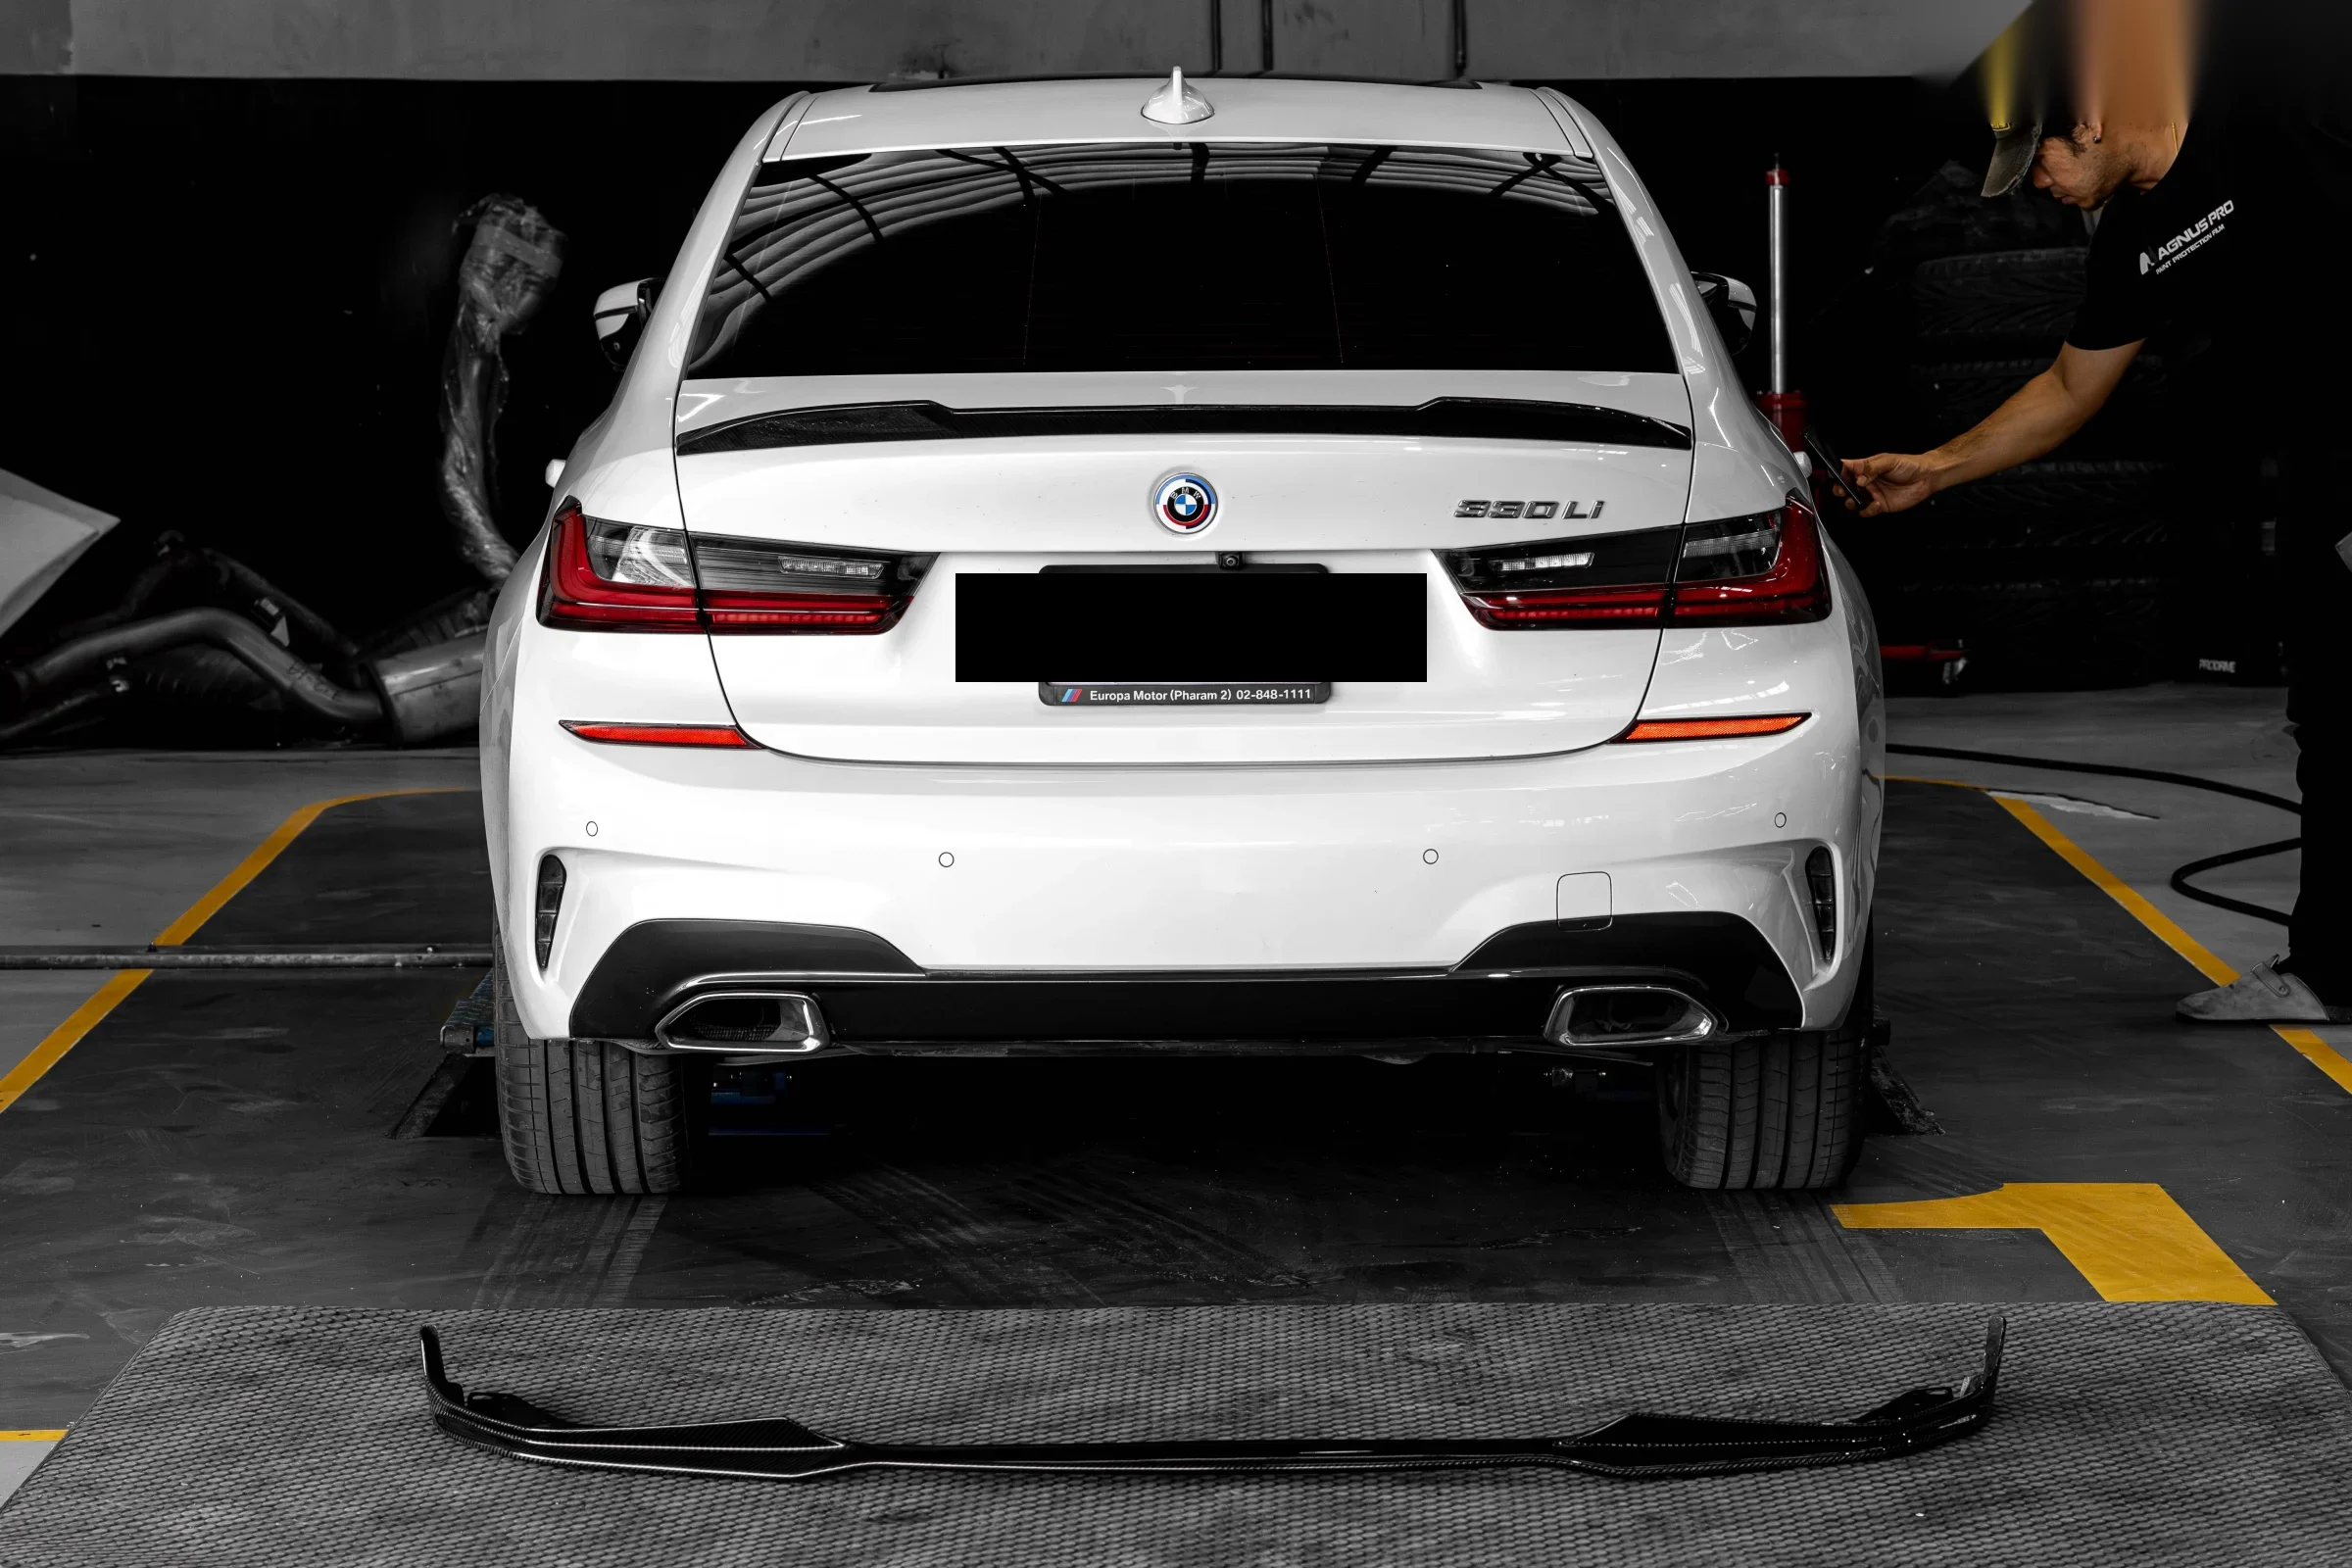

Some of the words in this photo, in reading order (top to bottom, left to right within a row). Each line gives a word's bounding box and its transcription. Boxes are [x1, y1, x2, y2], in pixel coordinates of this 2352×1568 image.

[2207, 199, 2234, 225] PRO
[2155, 260, 2173, 275] PAINT
[2172, 232, 2213, 264] PROTECTION
[2211, 223, 2226, 236] FILM
[1169, 487, 1201, 500] BMW
[1090, 690, 1131, 703] Europa
[1133, 690, 1168, 701] Motor
[1169, 689, 1218, 702] (Pharam
[1220, 688, 1232, 701] 2)
[1236, 689, 1311, 700] 02-848-1111
